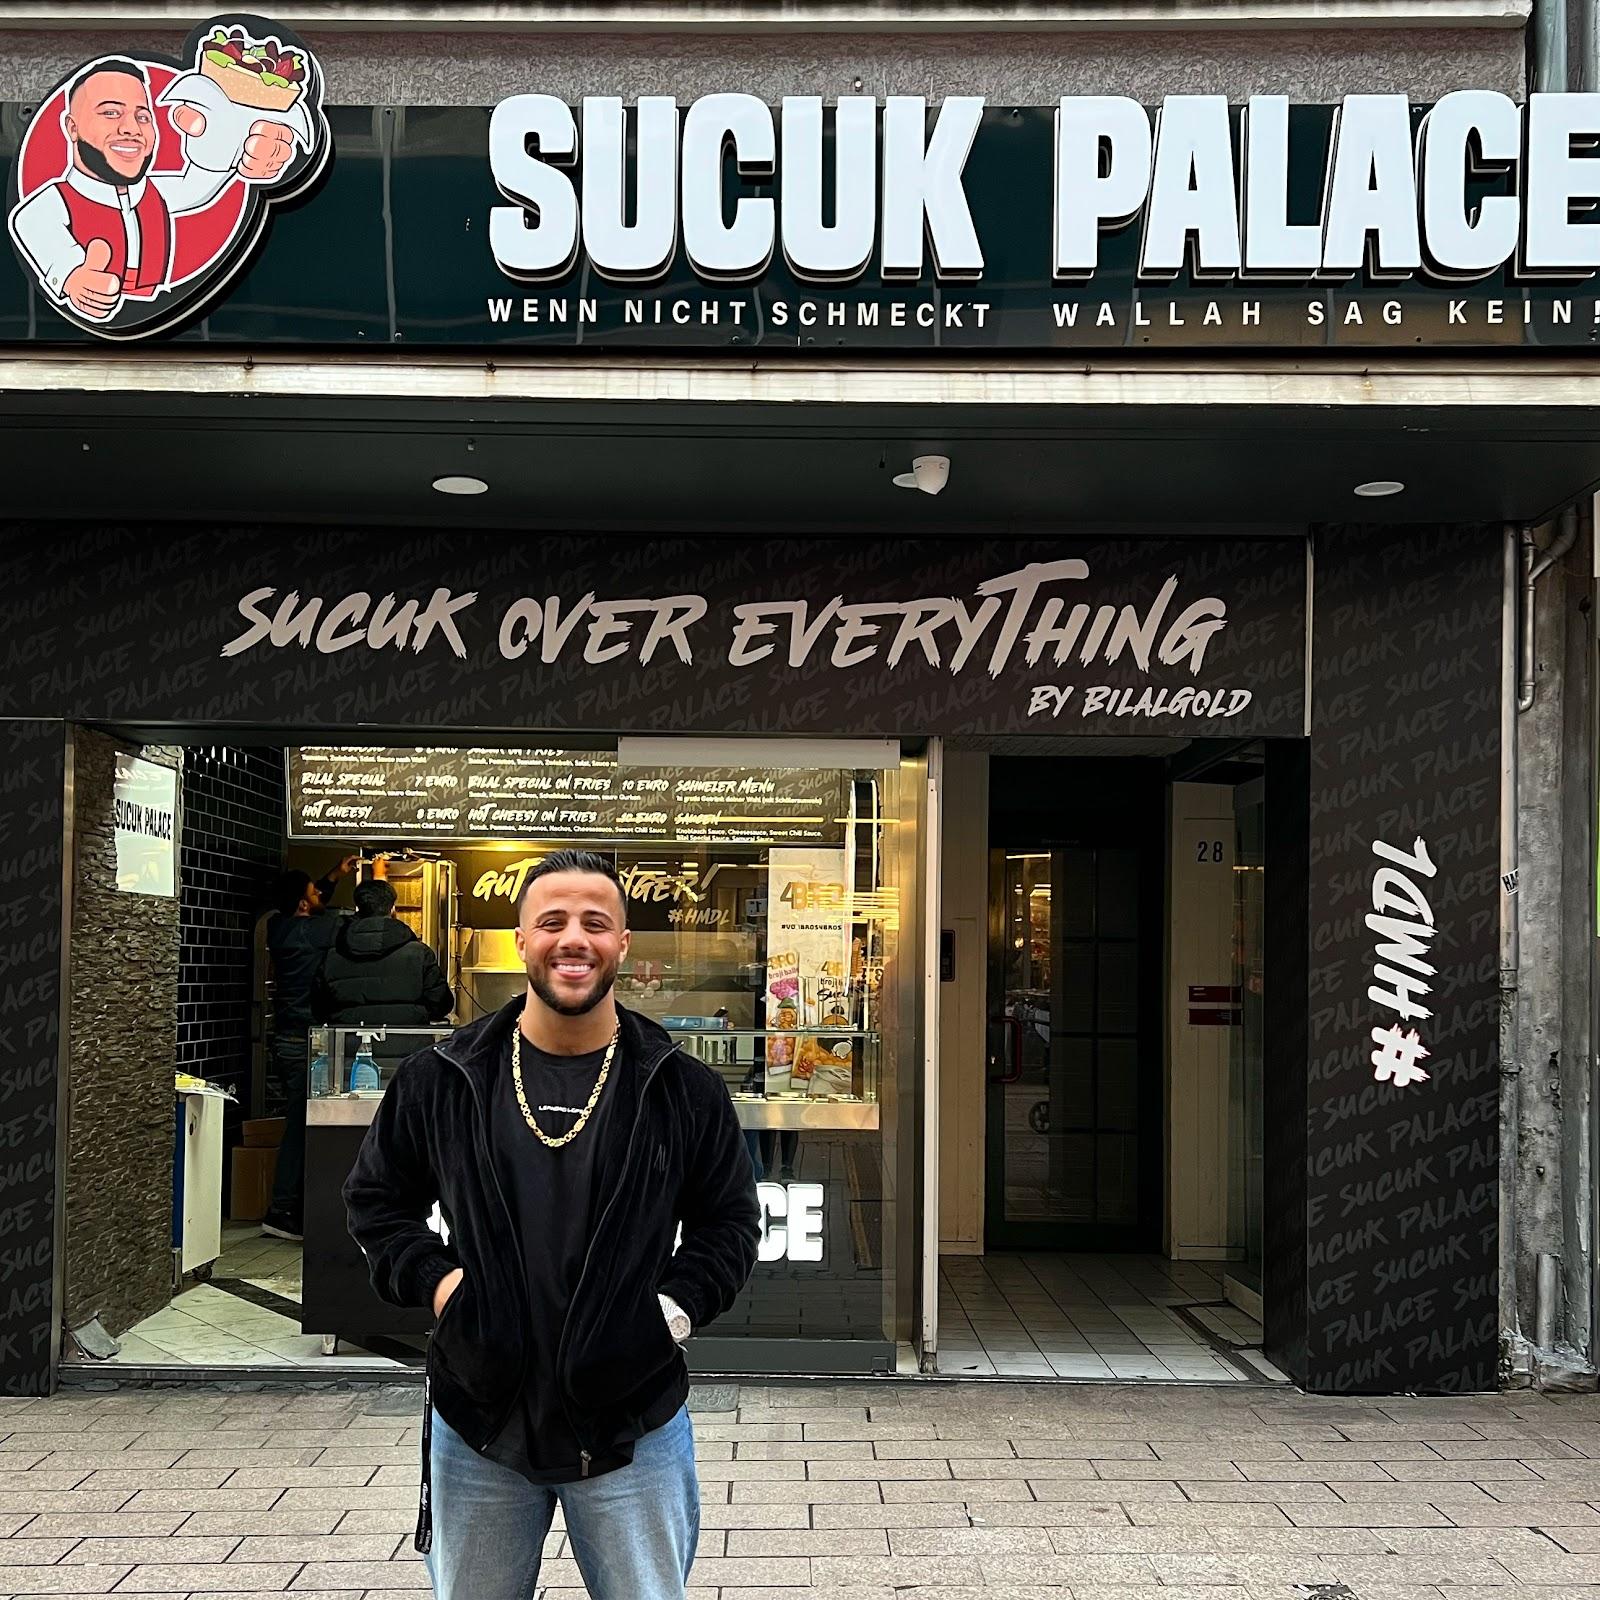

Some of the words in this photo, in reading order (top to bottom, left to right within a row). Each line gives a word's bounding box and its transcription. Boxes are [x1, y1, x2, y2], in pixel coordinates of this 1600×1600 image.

[488, 93, 986, 275] SUCUK
[1054, 89, 1600, 275] PALACE
[487, 297, 598, 324] WENN
[624, 299, 747, 326] NICHT
[772, 301, 990, 328] SCHMECKT
[1052, 301, 1263, 327] WALLAH
[1307, 300, 1404, 326] SAG
[219, 585, 479, 659] SUCUK
[498, 589, 708, 666] OVER
[727, 557, 1229, 680] EVERYTHING
[1384, 643, 1484, 709] SUCUK
[1026, 684, 1074, 719] BY
[1081, 684, 1253, 719] BILALGOLD
[300, 771, 335, 786] BILAL
[336, 772, 387, 787] SPECIAL
[415, 775, 424, 788] 7
[425, 774, 459, 789] EURO
[467, 775, 501, 789] BILAL
[502, 776, 553, 790] SPECIAL
[555, 773, 573, 790] ON
[573, 777, 612, 791] FRIES
[622, 779, 635, 791] 10
[636, 779, 670, 792] EURO
[115, 798, 143, 834] SUCUK
[144, 806, 172, 841] PALACE
[301, 799, 332, 819] HOT
[325, 805, 373, 820] CHEESY
[426, 808, 460, 821] EURO
[467, 802, 498, 823] HOT
[491, 808, 539, 823] CHEESY
[541, 806, 559, 823] ON
[559, 809, 598, 824] FRIES
[635, 811, 668, 825] EURO
[675, 827, 708, 836] Knoblauch
[1196, 840, 1224, 863] 28
[667, 907, 731, 926] #HMDL
[1364, 835, 1439, 1088] #HMDL
[1386, 1087, 1499, 1153] PALACE
[1338, 1155, 1440, 1218] SUCUK
[1372, 1232, 1472, 1295] SUCUK
[1321, 1287, 1440, 1353] PALACE
